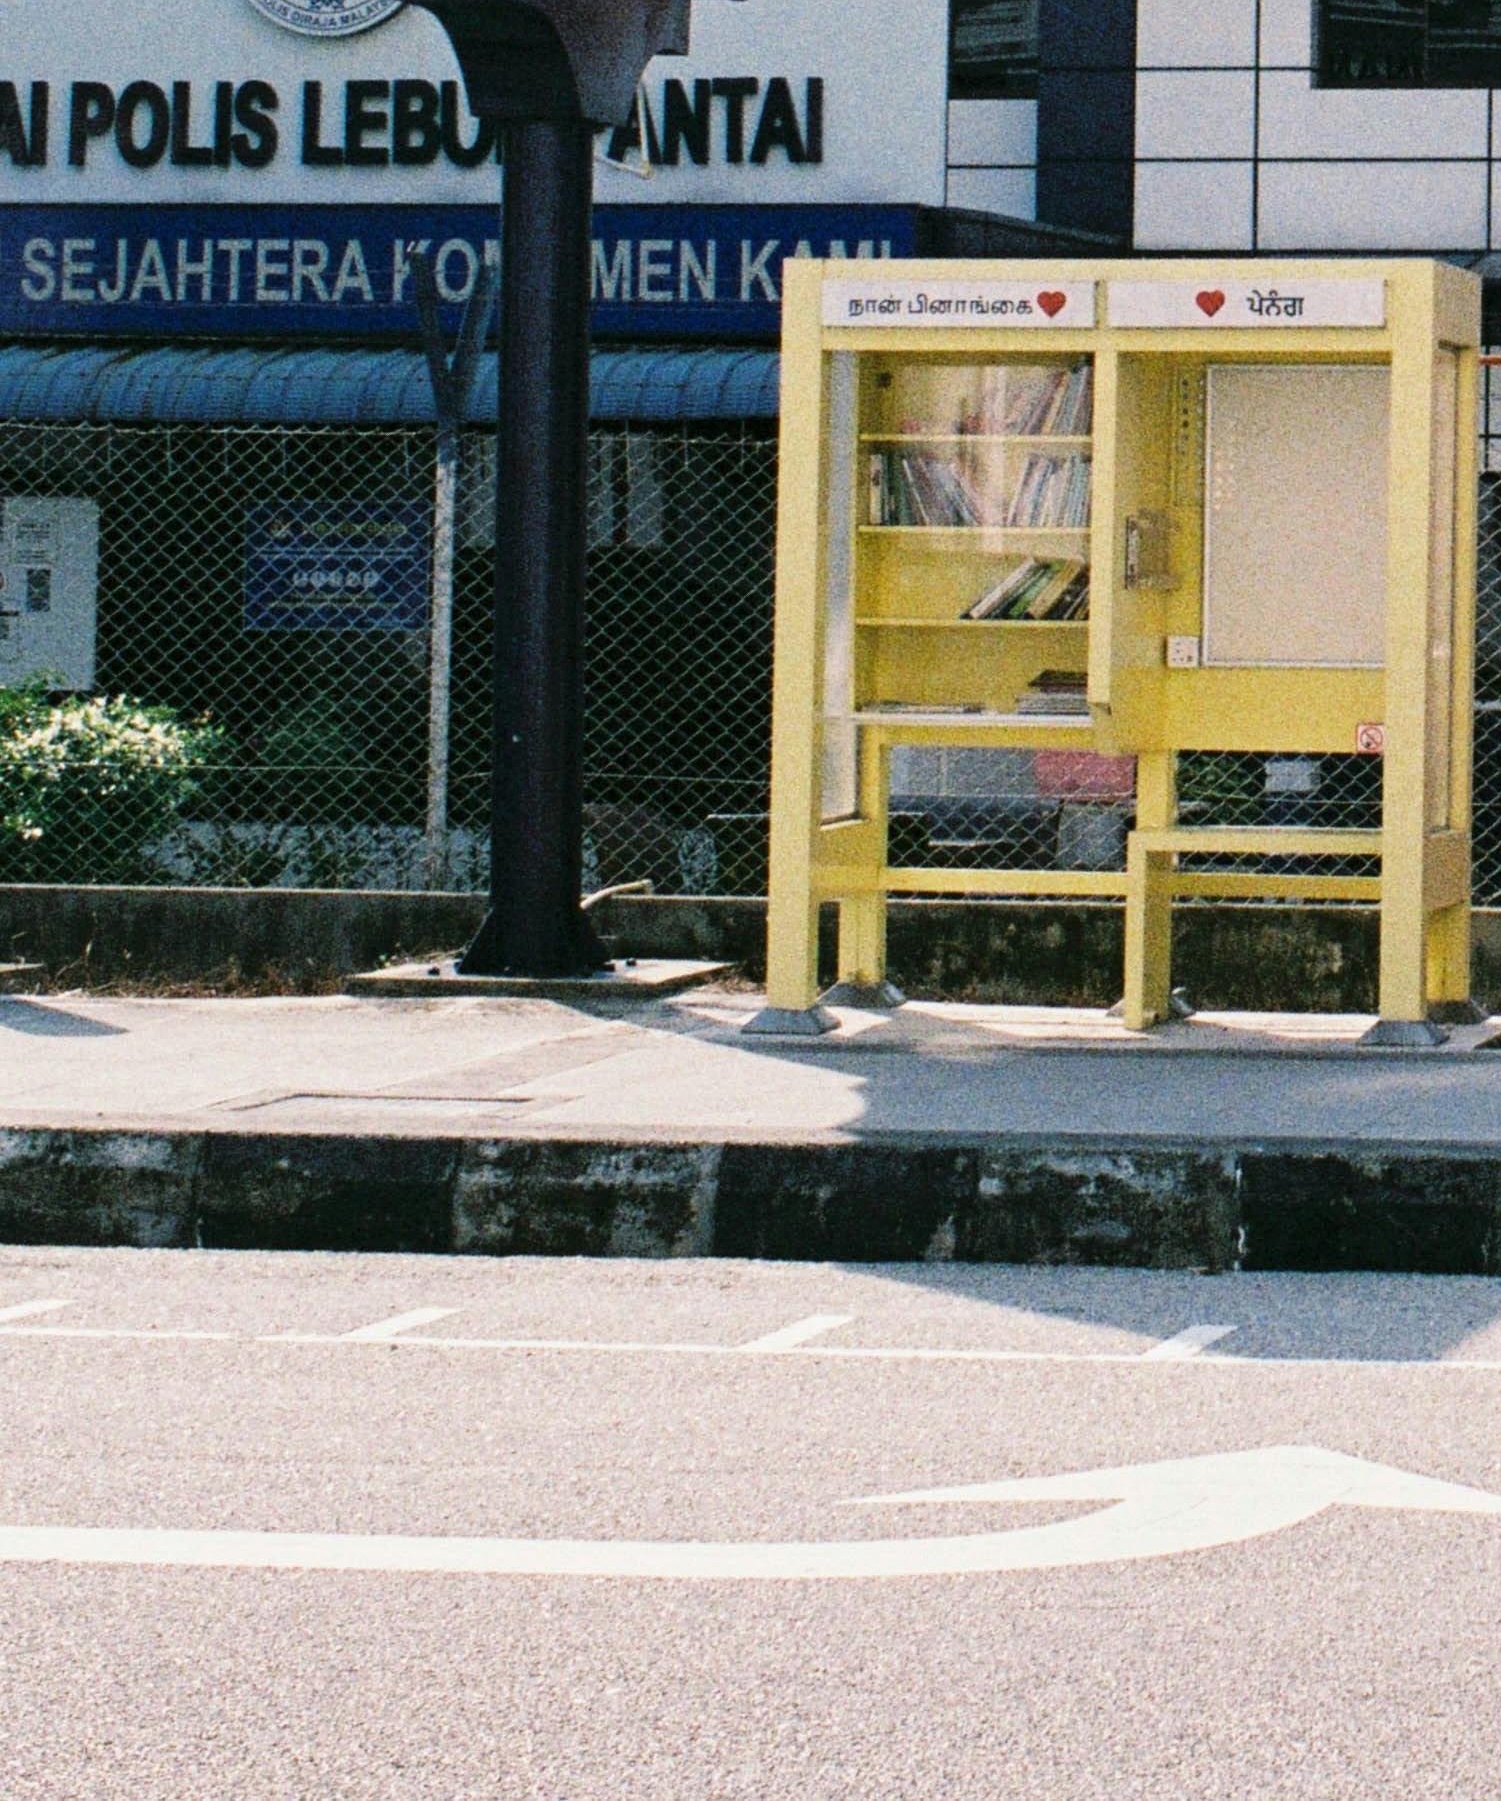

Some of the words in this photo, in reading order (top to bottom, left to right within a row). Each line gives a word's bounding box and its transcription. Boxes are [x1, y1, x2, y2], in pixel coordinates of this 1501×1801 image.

[67, 80, 280, 168] POLIS
[300, 78, 502, 168] LEBU
[20, 237, 375, 303] SEJAHTERA
[848, 294, 901, 316] நான்
